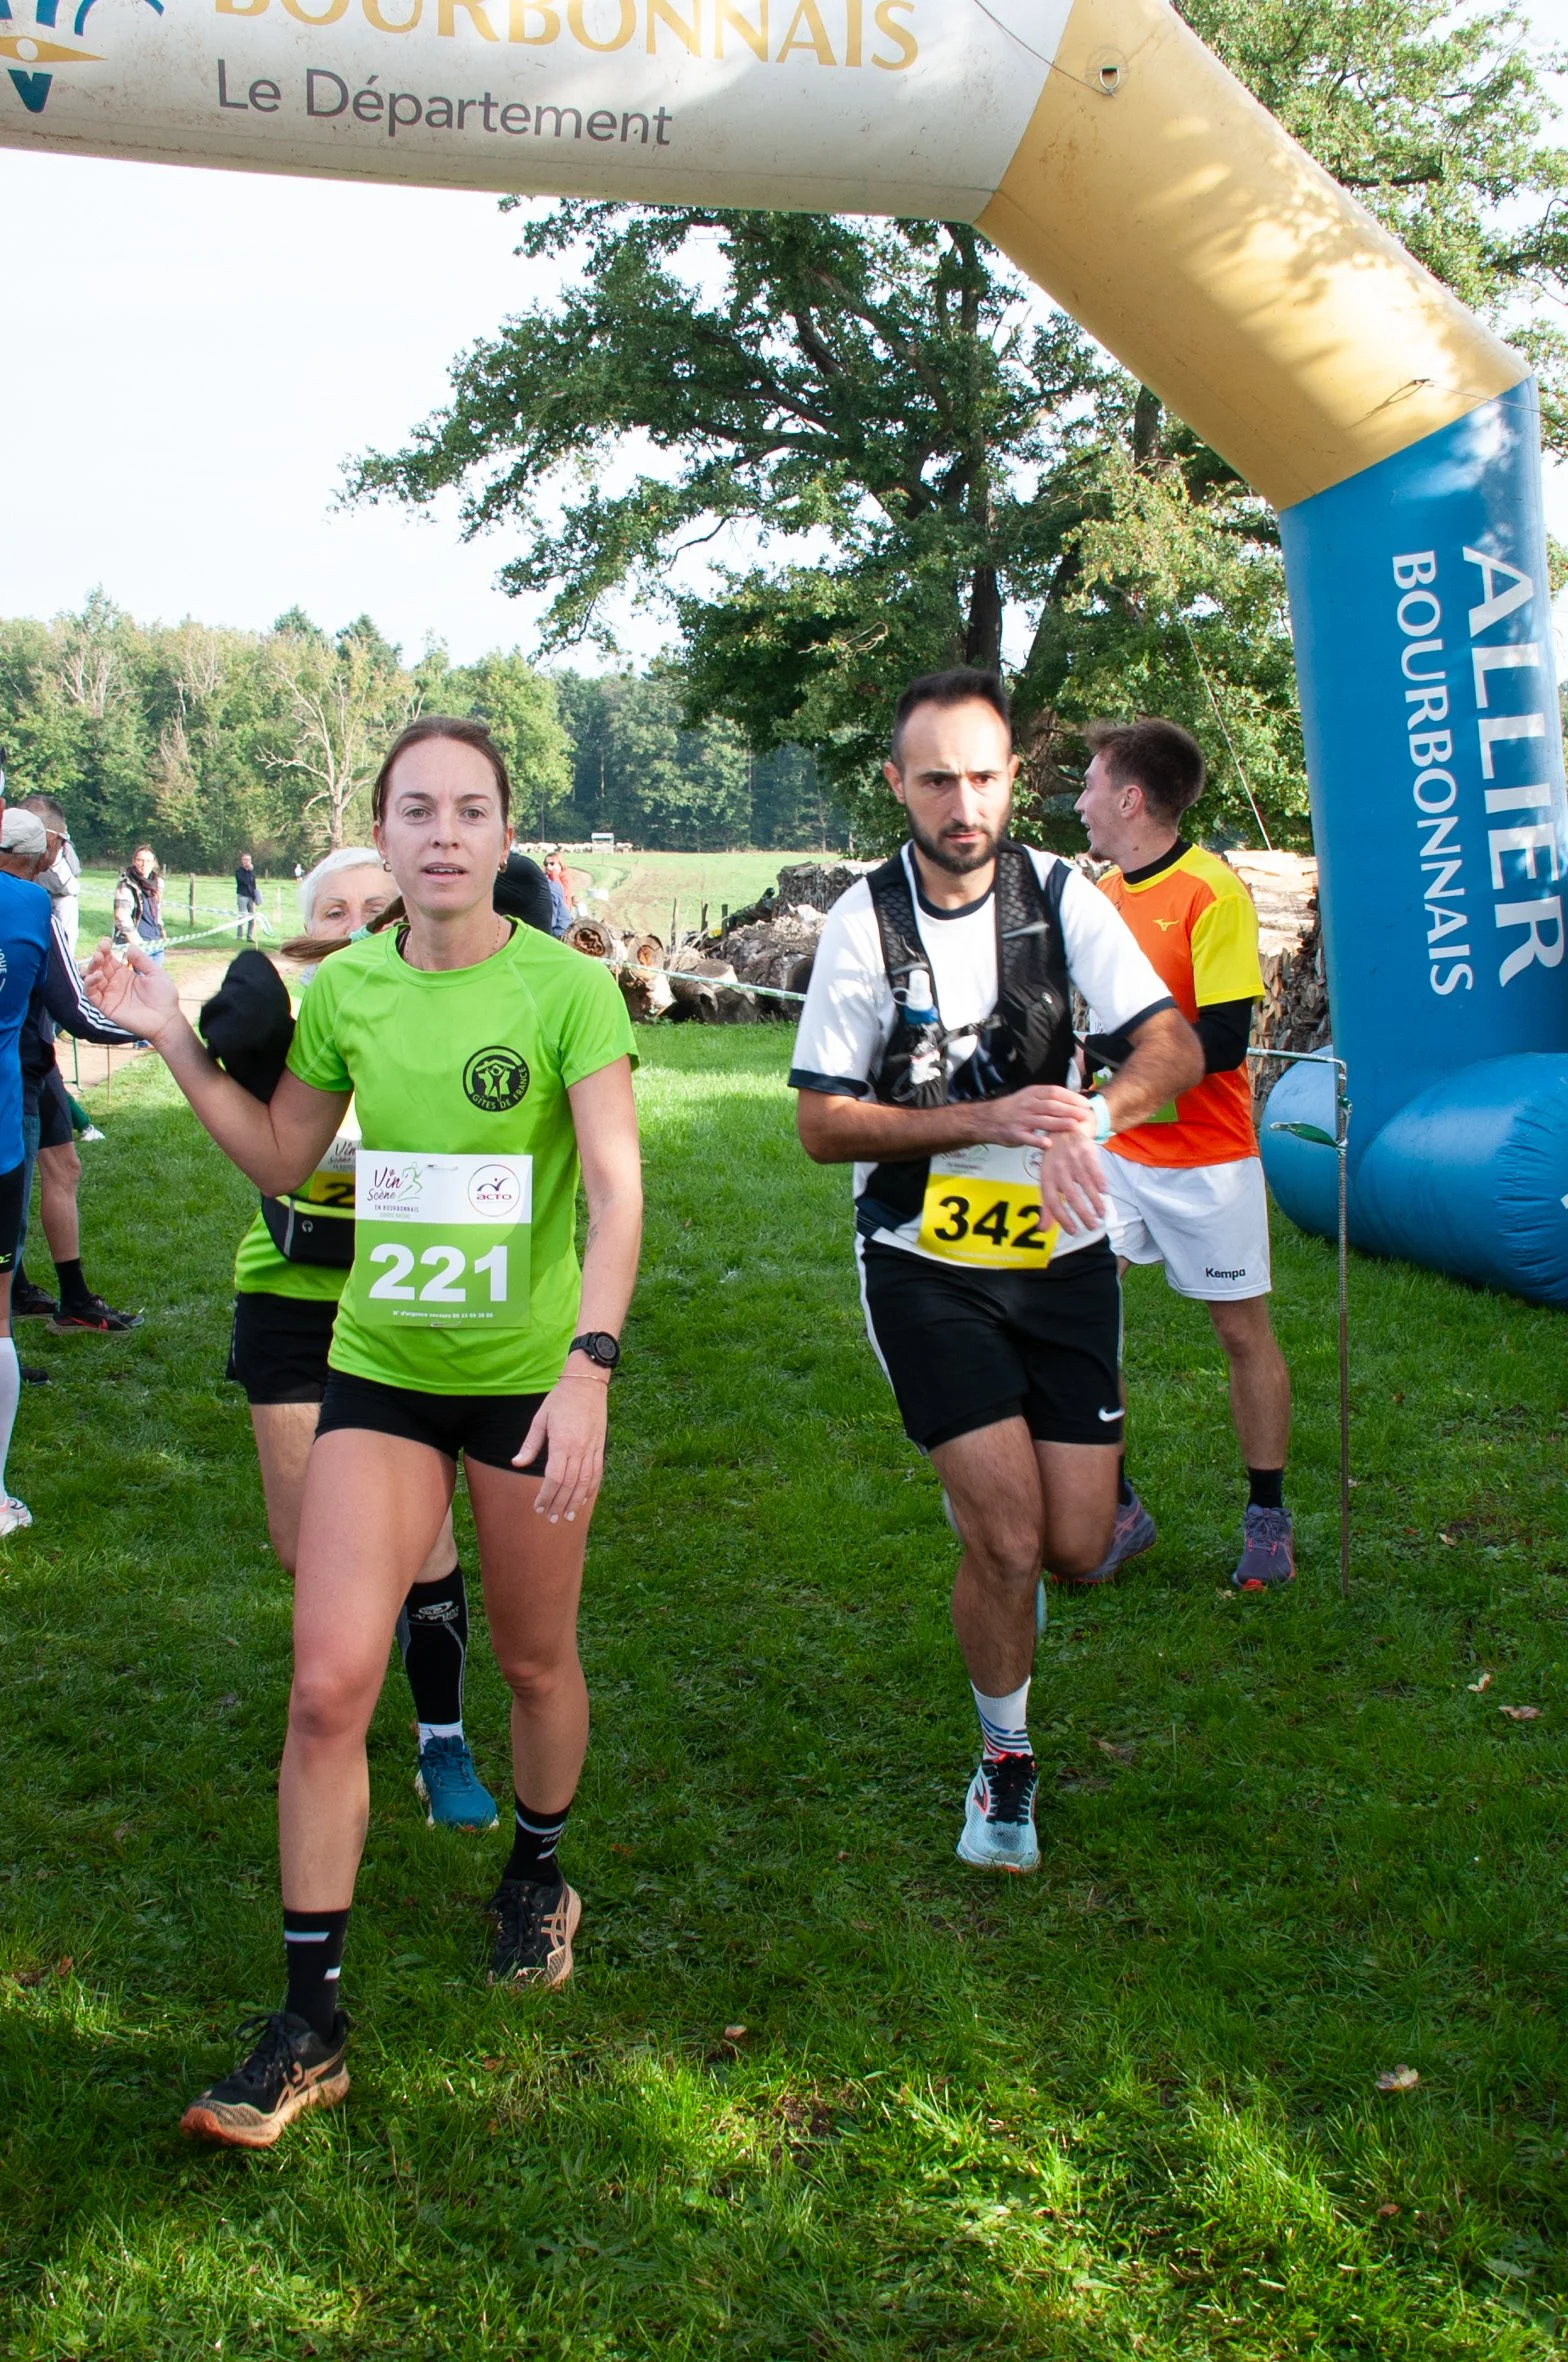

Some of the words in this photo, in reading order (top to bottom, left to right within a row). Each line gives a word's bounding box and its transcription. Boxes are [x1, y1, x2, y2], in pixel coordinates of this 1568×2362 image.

[215, 0, 918, 71] URBONNAIS
[217, 59, 282, 114] Le
[306, 68, 674, 147] Département
[1392, 549, 1474, 997] BOURBONNAIS
[1462, 546, 1565, 988] ALLIER
[500, 1098, 513, 1109] DE
[512, 1066, 529, 1101] FRANCE
[934, 1195, 1046, 1250] 342
[368, 1243, 509, 1303] 221
[1205, 1267, 1246, 1281] Kempa
